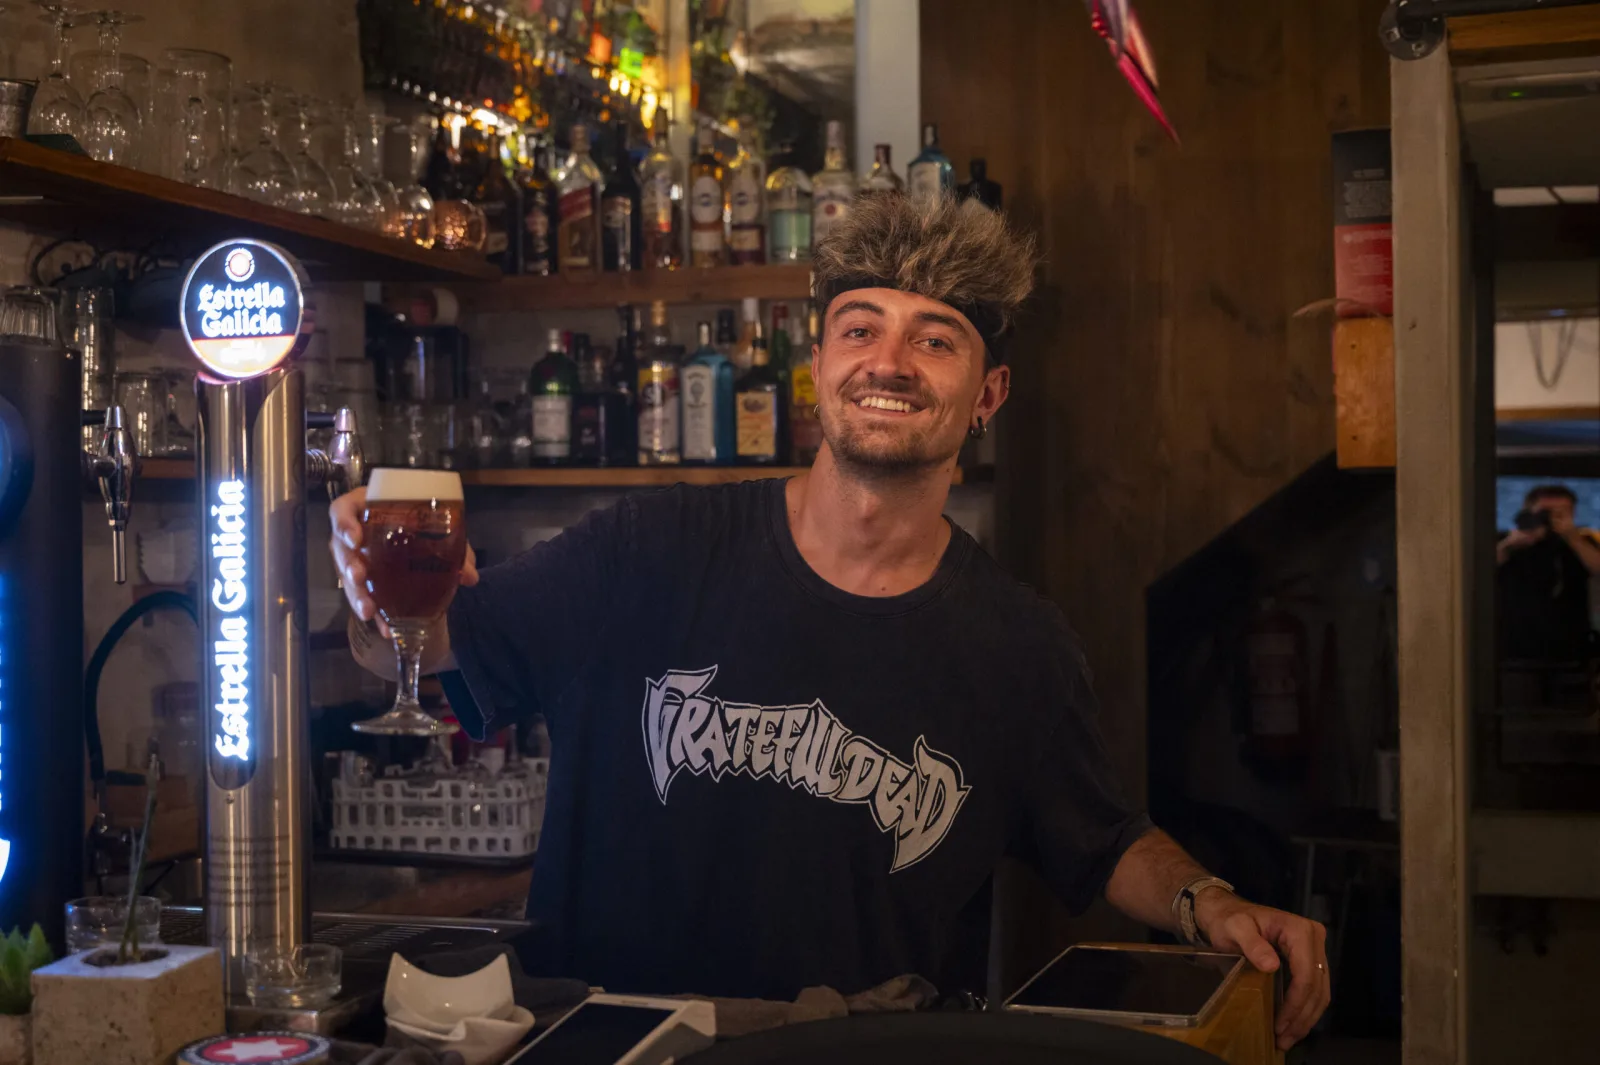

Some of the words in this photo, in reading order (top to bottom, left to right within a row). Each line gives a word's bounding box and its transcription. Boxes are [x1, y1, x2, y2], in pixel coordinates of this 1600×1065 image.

[198, 282, 286, 311] Estrella
[201, 308, 283, 337] Galicia
[211, 479, 247, 612] Galicia
[214, 616, 250, 761] Estrella
[643, 664, 852, 805] GRATEFUL
[832, 735, 972, 874] DEAD
